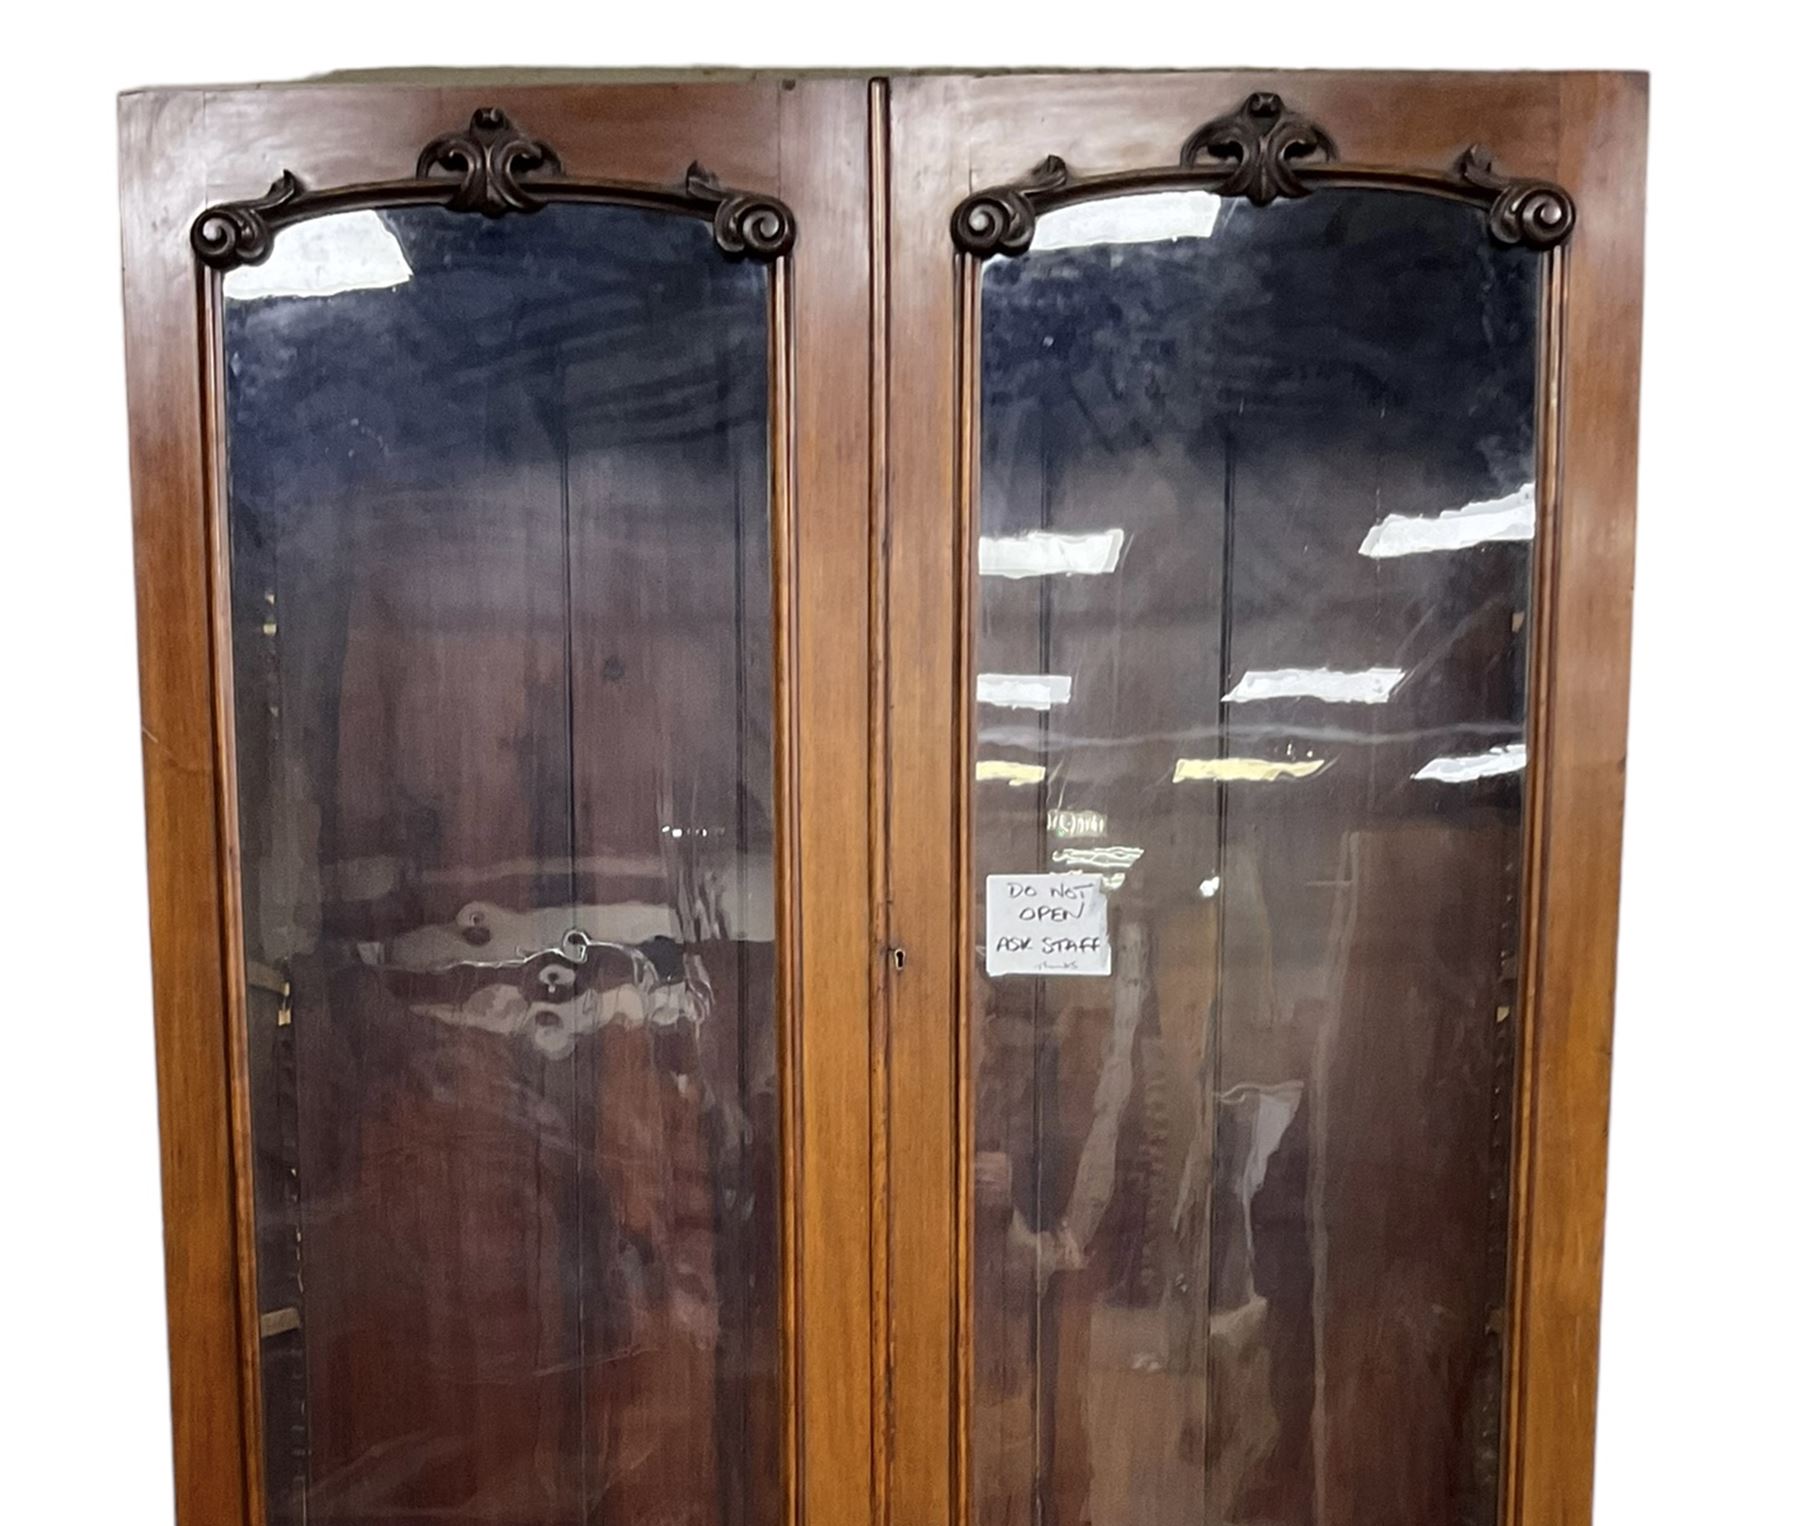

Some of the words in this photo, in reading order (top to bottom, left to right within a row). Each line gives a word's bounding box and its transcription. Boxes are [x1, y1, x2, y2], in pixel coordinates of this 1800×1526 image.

[1007, 882, 1037, 898] DO
[1050, 883, 1094, 899] NOT
[1019, 902, 1085, 922] OPEN
[996, 936, 1032, 952] ASK
[1042, 937, 1100, 954] STAFF
